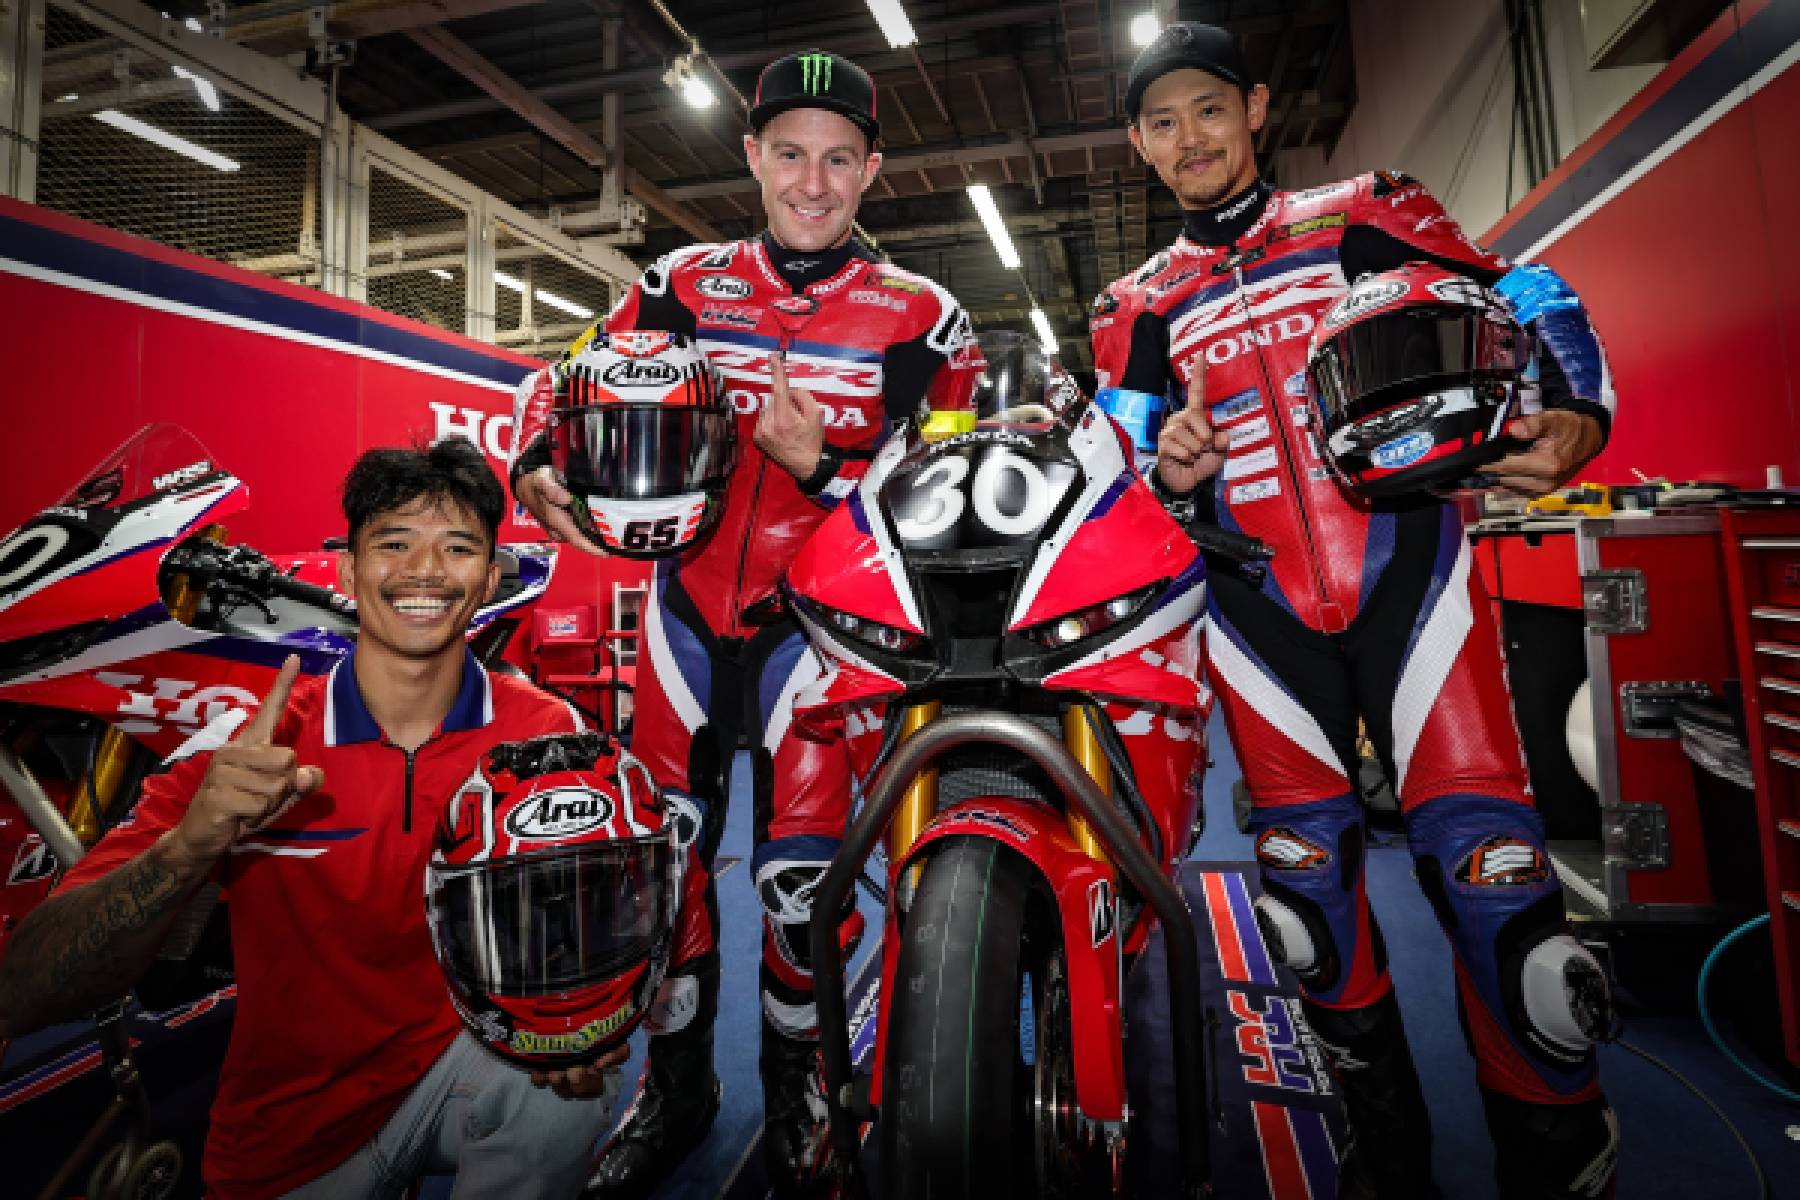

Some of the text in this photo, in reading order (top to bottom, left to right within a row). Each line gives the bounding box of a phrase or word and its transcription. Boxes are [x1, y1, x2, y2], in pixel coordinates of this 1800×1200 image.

[612, 359, 672, 381] Arai
[1178, 310, 1318, 381] HOND
[896, 446, 1053, 539] 30
[622, 515, 681, 550] 65
[514, 797, 600, 827] Arai
[1226, 989, 1316, 1093] HRC
